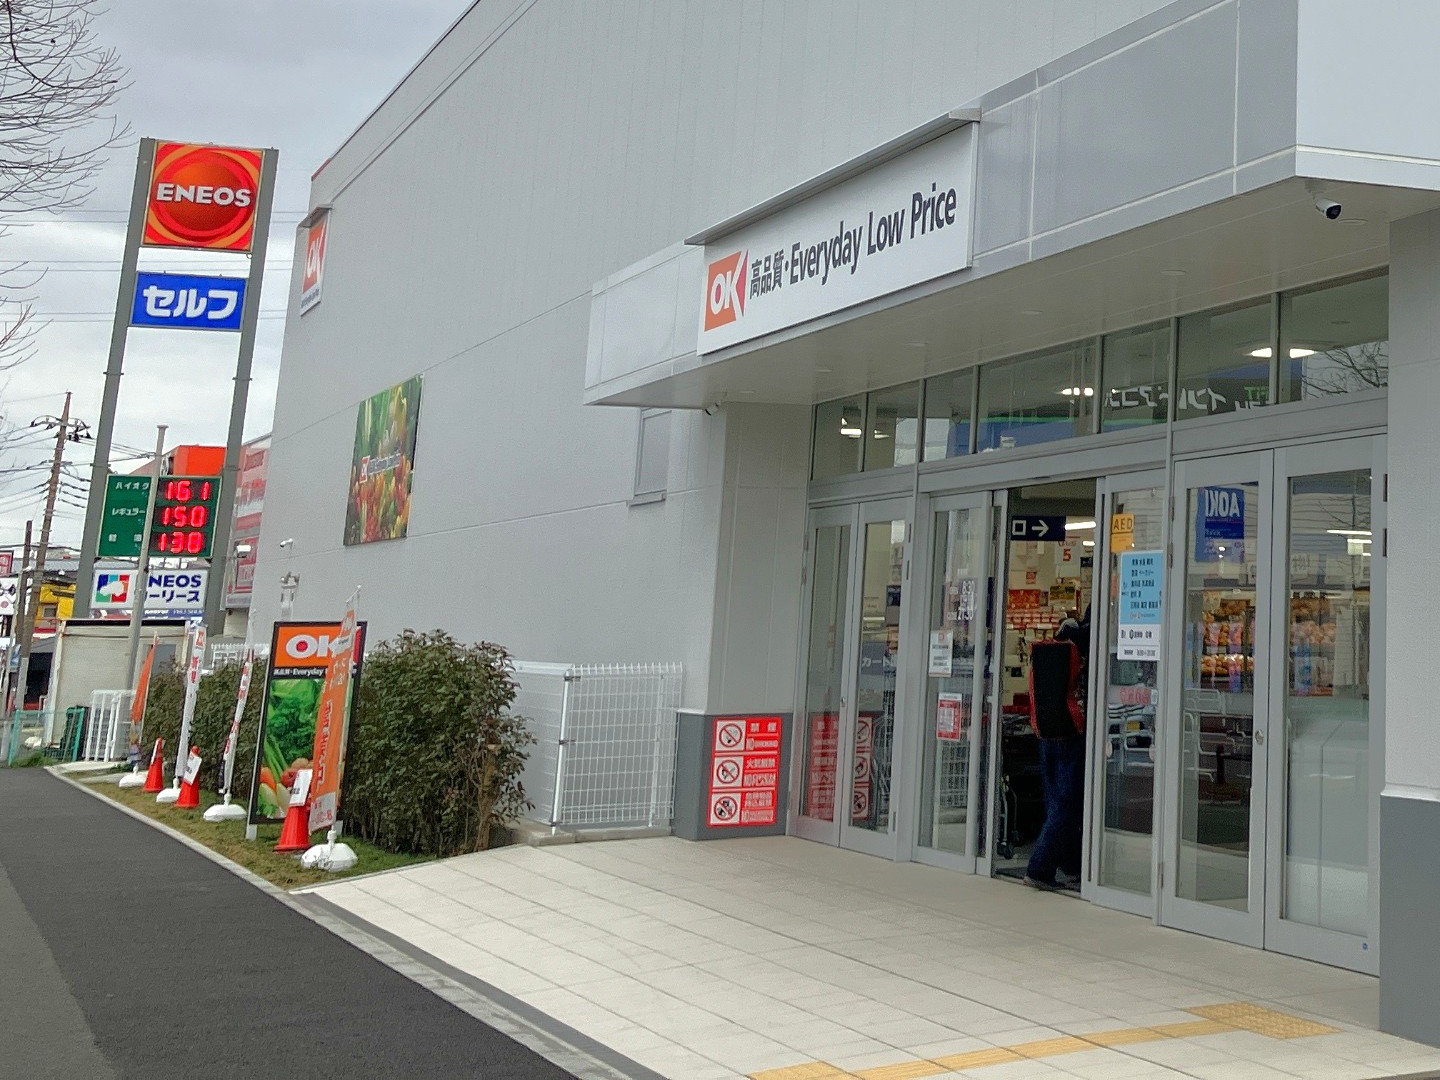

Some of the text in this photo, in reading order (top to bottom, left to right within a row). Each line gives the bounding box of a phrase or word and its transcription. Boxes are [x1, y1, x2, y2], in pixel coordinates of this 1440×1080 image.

[156, 183, 251, 207] ENEOS
[867, 209, 905, 256] Low
[910, 182, 957, 239] Price
[710, 249, 748, 317] OK
[143, 285, 239, 319] セルフ
[162, 505, 207, 528] 150
[1114, 518, 1132, 530] AED
[149, 574, 201, 588] NEOS
[145, 590, 200, 603] ーリース
